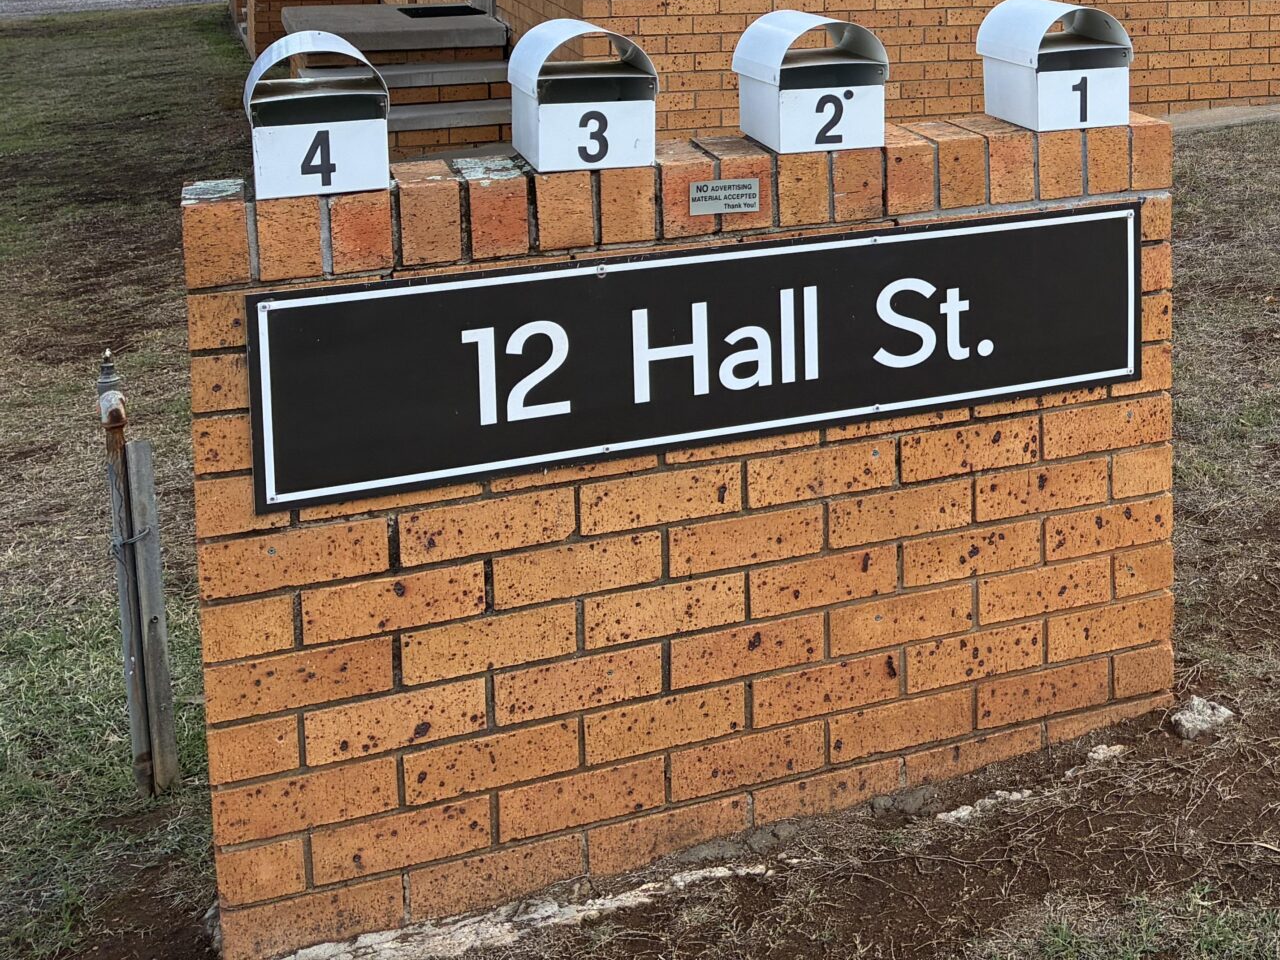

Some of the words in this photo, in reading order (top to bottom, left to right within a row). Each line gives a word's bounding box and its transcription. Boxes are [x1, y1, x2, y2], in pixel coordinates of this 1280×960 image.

[814, 94, 844, 145] 2
[1072, 76, 1088, 123] 1
[300, 129, 337, 187] 4
[577, 110, 609, 164] 3
[692, 195, 722, 203] MATERIAL
[696, 184, 708, 193] NO
[711, 184, 752, 192] ADVERTISING
[461, 320, 571, 426] 12
[631, 285, 819, 404] Hall
[872, 277, 994, 369] St.
